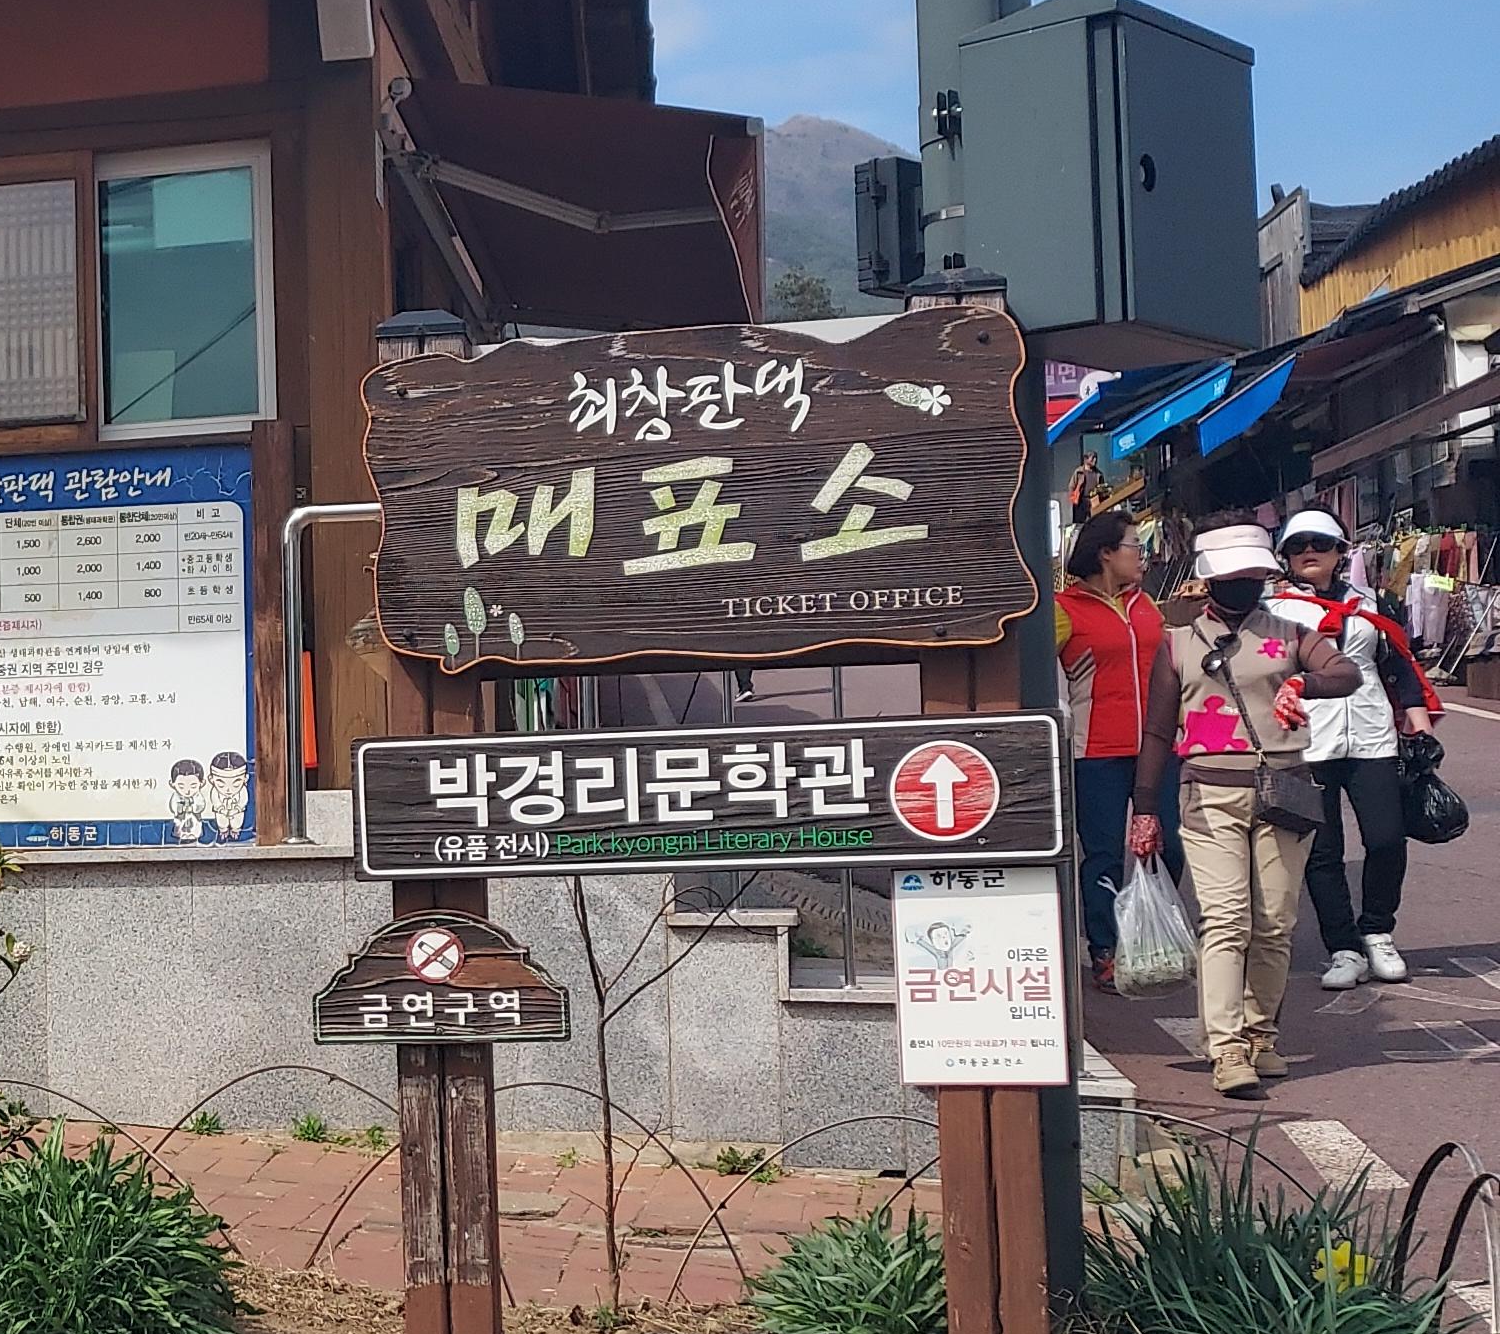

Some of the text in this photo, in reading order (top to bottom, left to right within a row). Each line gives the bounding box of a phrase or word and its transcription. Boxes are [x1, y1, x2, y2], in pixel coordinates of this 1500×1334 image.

[64, 467, 172, 502] 관람안내
[16, 539, 41, 549] 1,500
[76, 536, 102, 546] 2,600
[135, 533, 161, 544] 2,000
[17, 566, 41, 576] 1,000
[76, 563, 102, 574] 2,000
[136, 560, 161, 571] 1,400
[24, 593, 41, 603] 500
[78, 591, 102, 601] 1,400
[144, 588, 162, 598] 800
[721, 586, 964, 618] TICKET OFFICE
[21, 662, 43, 675] 지역
[46, 661, 79, 674] 주민인
[83, 660, 104, 673] 경우
[429, 738, 875, 828] 박경리문학관
[50, 825, 98, 842] 하동군
[434, 832, 550, 861] (유품 전시)
[556, 825, 873, 858] Park kyongni Literary House
[929, 869, 1005, 890] 하동군
[1007, 948, 1049, 962] 이곳은
[905, 966, 1052, 1003] 금연시설
[358, 990, 522, 1028] 금연구역
[1009, 1006, 1056, 1020] 입니다.
